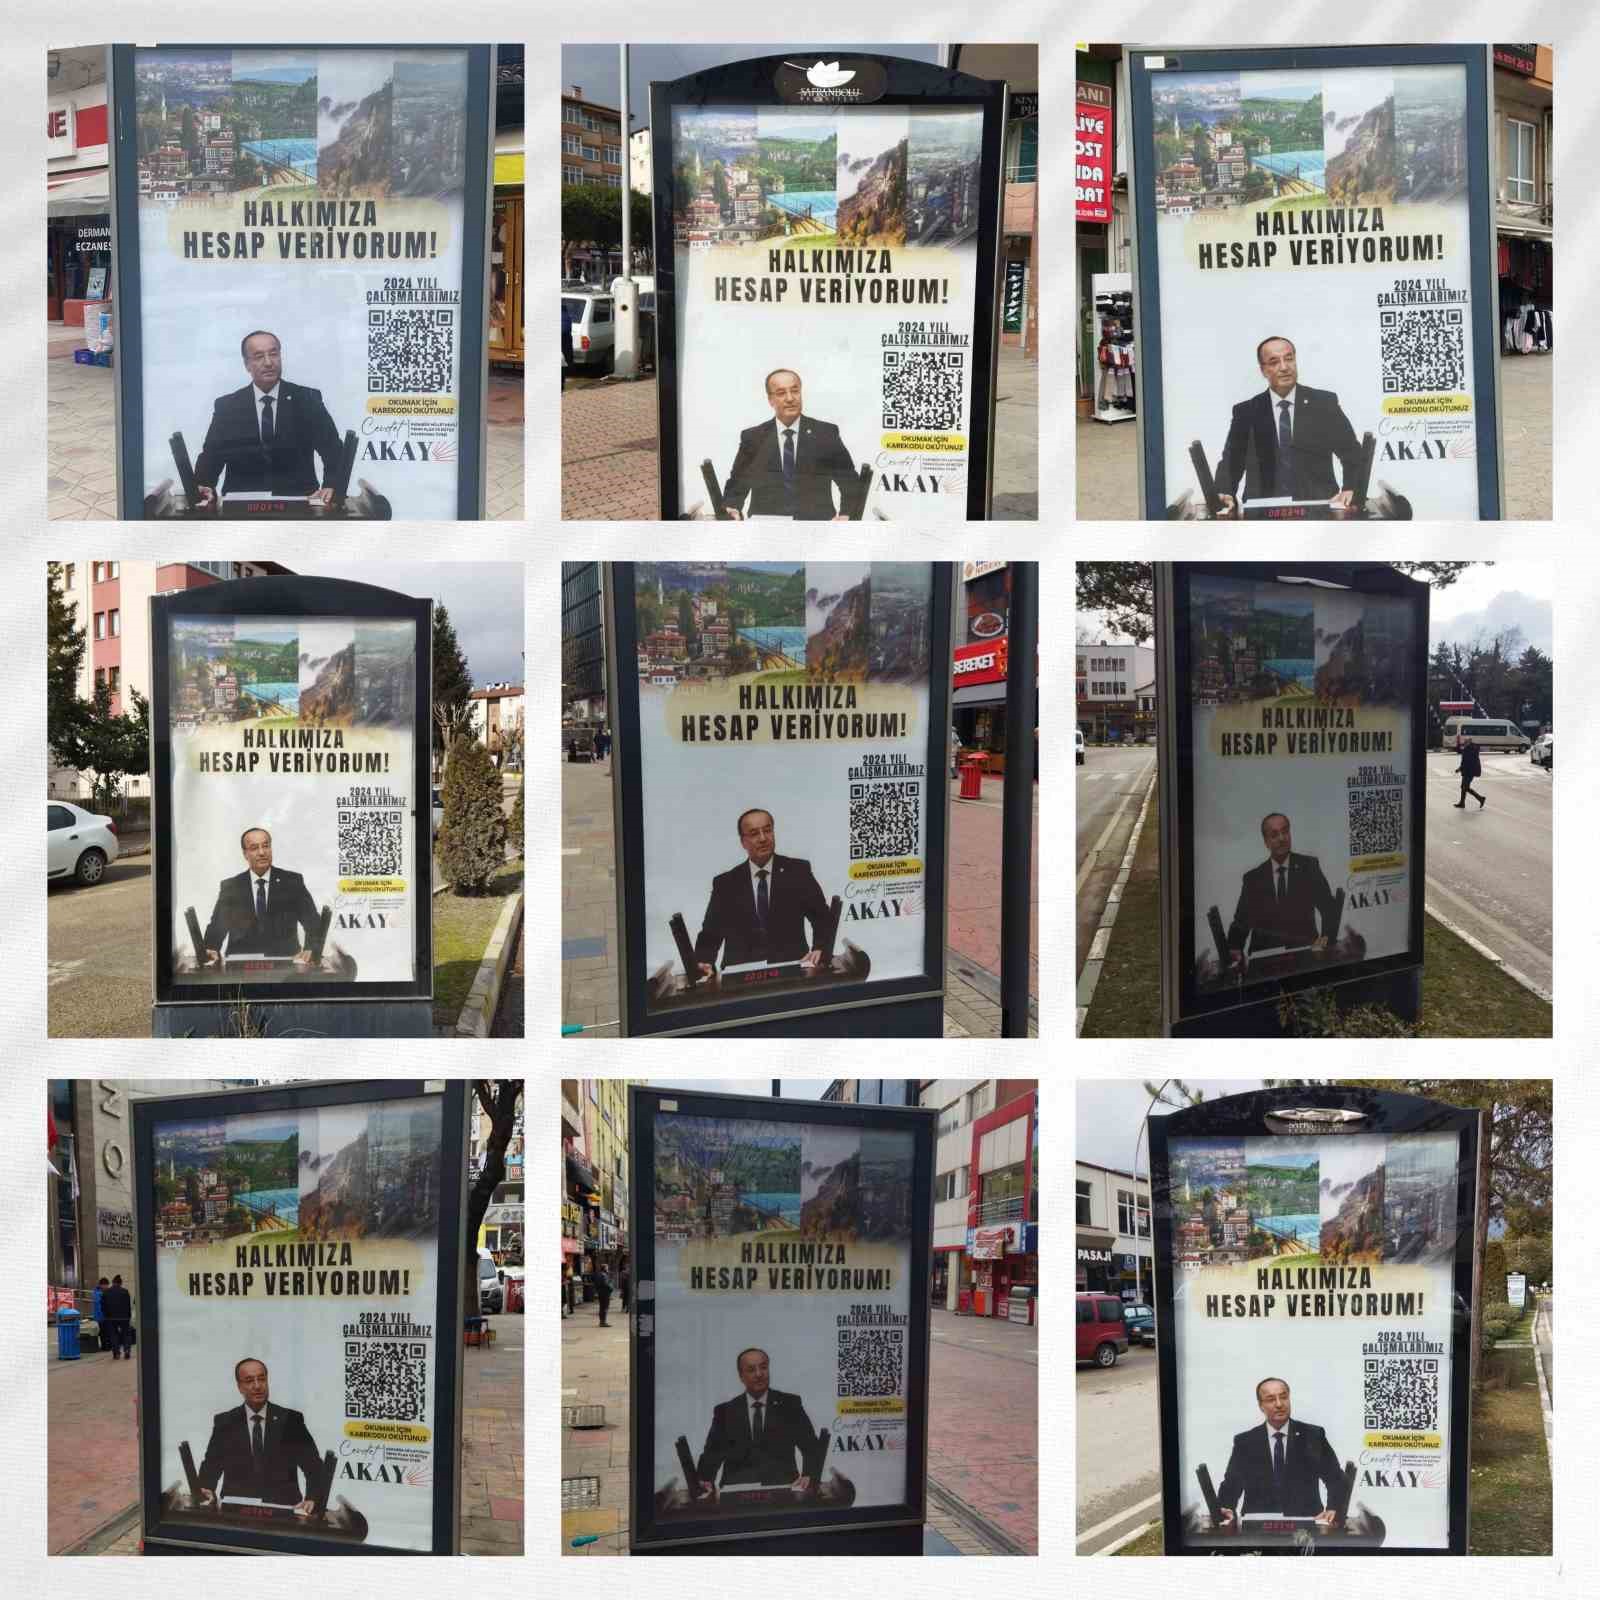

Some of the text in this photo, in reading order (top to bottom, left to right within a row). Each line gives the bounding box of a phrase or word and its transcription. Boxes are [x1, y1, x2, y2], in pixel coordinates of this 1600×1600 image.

[243, 201, 377, 227] HALKIMIZA
[1255, 208, 1385, 235] HALKIMIZA
[183, 228, 437, 259] HESAP VERİYORUM!
[1199, 233, 1444, 270] HESAP VERİYORUM!
[768, 249, 892, 274] HALKIMIZA
[384, 277, 438, 290] 2024 YILI
[714, 274, 949, 304] HESAP VERİYORUM!
[1394, 279, 1446, 291] 2024 YILI
[366, 291, 460, 304] ÇALIŞMALARIMIZ
[1377, 290, 1469, 306] ÇALIŞMALARIMIZ
[898, 322, 950, 334] 2024 YILI
[881, 334, 970, 347] ÇALIŞMALARIMIZ
[362, 440, 433, 461] AKAY
[1380, 440, 1450, 461] AKAY
[879, 473, 943, 493] AKAY
[739, 685, 857, 710] HALKIMIZA
[681, 710, 906, 742] HESAP VERİYORUM!
[1262, 707, 1355, 729] HALKIMIZA
[243, 728, 344, 748] HALKIMIZA
[1222, 729, 1392, 756] HESAP VERİYORUM!
[199, 749, 390, 773] HESAP VERİYORUM!
[862, 754, 907, 766] 2024 YILI
[848, 765, 926, 779] ÇALIŞMALARIMIZ
[844, 898, 903, 921] AKAY
[336, 913, 387, 929] AKAY
[235, 1243, 353, 1267] HALKIMIZA
[741, 1242, 846, 1264] HALKIMIZA
[189, 1267, 409, 1296] HESAP VERİYORUM!
[691, 1264, 891, 1290] HESAP VERİYORUM!
[1257, 1266, 1372, 1289] HALKIMIZA
[1206, 1290, 1424, 1318] HESAP VERİYORUM!
[359, 1313, 411, 1325] 2024 YILI
[342, 1324, 432, 1338] ÇALIŞMALARIMIZ
[1377, 1332, 1425, 1343] 2024 YILI
[1362, 1342, 1444, 1356] ÇALIŞMALARIMIZ
[832, 1434, 888, 1452] AKAY
[340, 1461, 407, 1484] AKAY
[1360, 1470, 1421, 1487] AKAY
